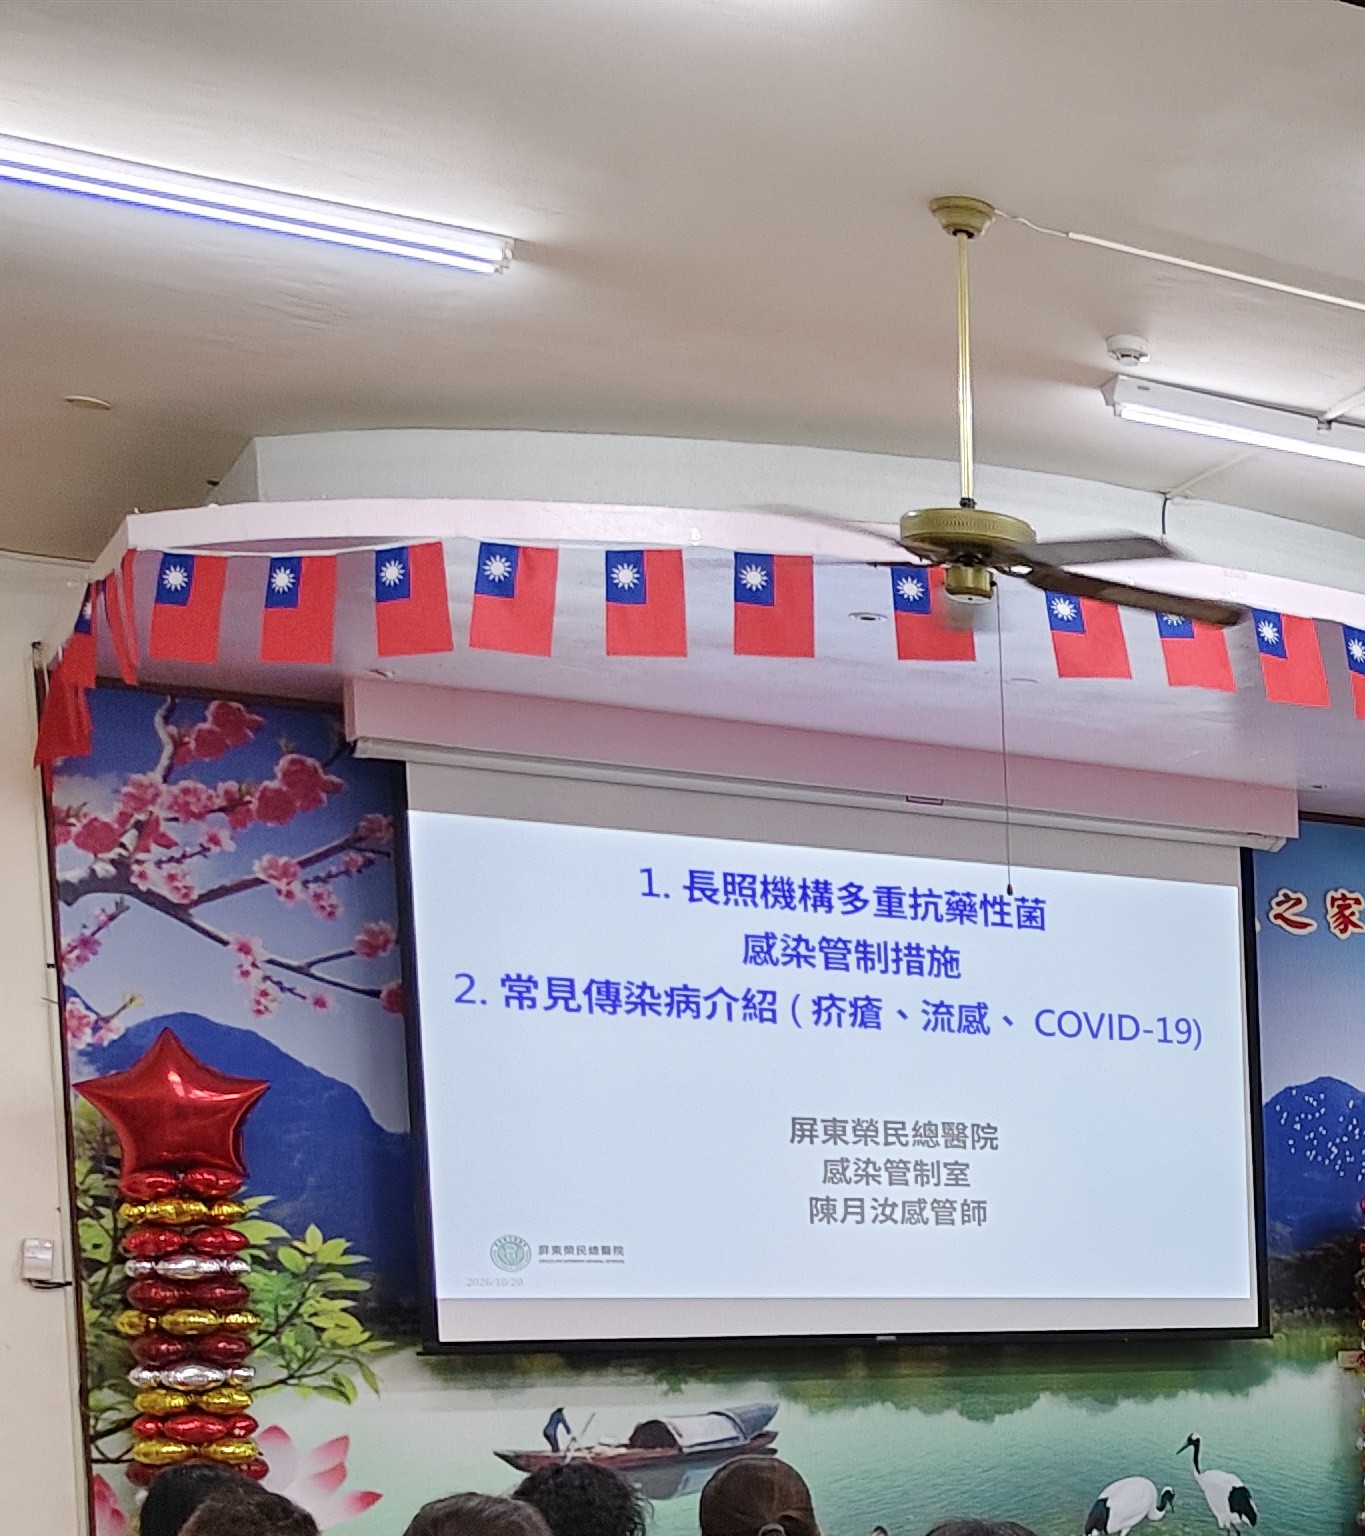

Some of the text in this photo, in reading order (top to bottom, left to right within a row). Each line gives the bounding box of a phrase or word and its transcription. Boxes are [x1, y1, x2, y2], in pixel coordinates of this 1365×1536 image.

[639, 867, 1047, 932] 1. 長照機構多重抗藥性菌
[742, 931, 963, 980] 感染管制措施
[453, 973, 488, 1006] 2.
[500, 973, 779, 1025] 常見傳染病介紹
[1034, 1008, 1203, 1052] COVID-19)
[789, 1116, 1000, 1151] 屏東榮民總醫院
[822, 1157, 972, 1188] 感染管制室
[808, 1195, 988, 1227] 陳月汝感管師
